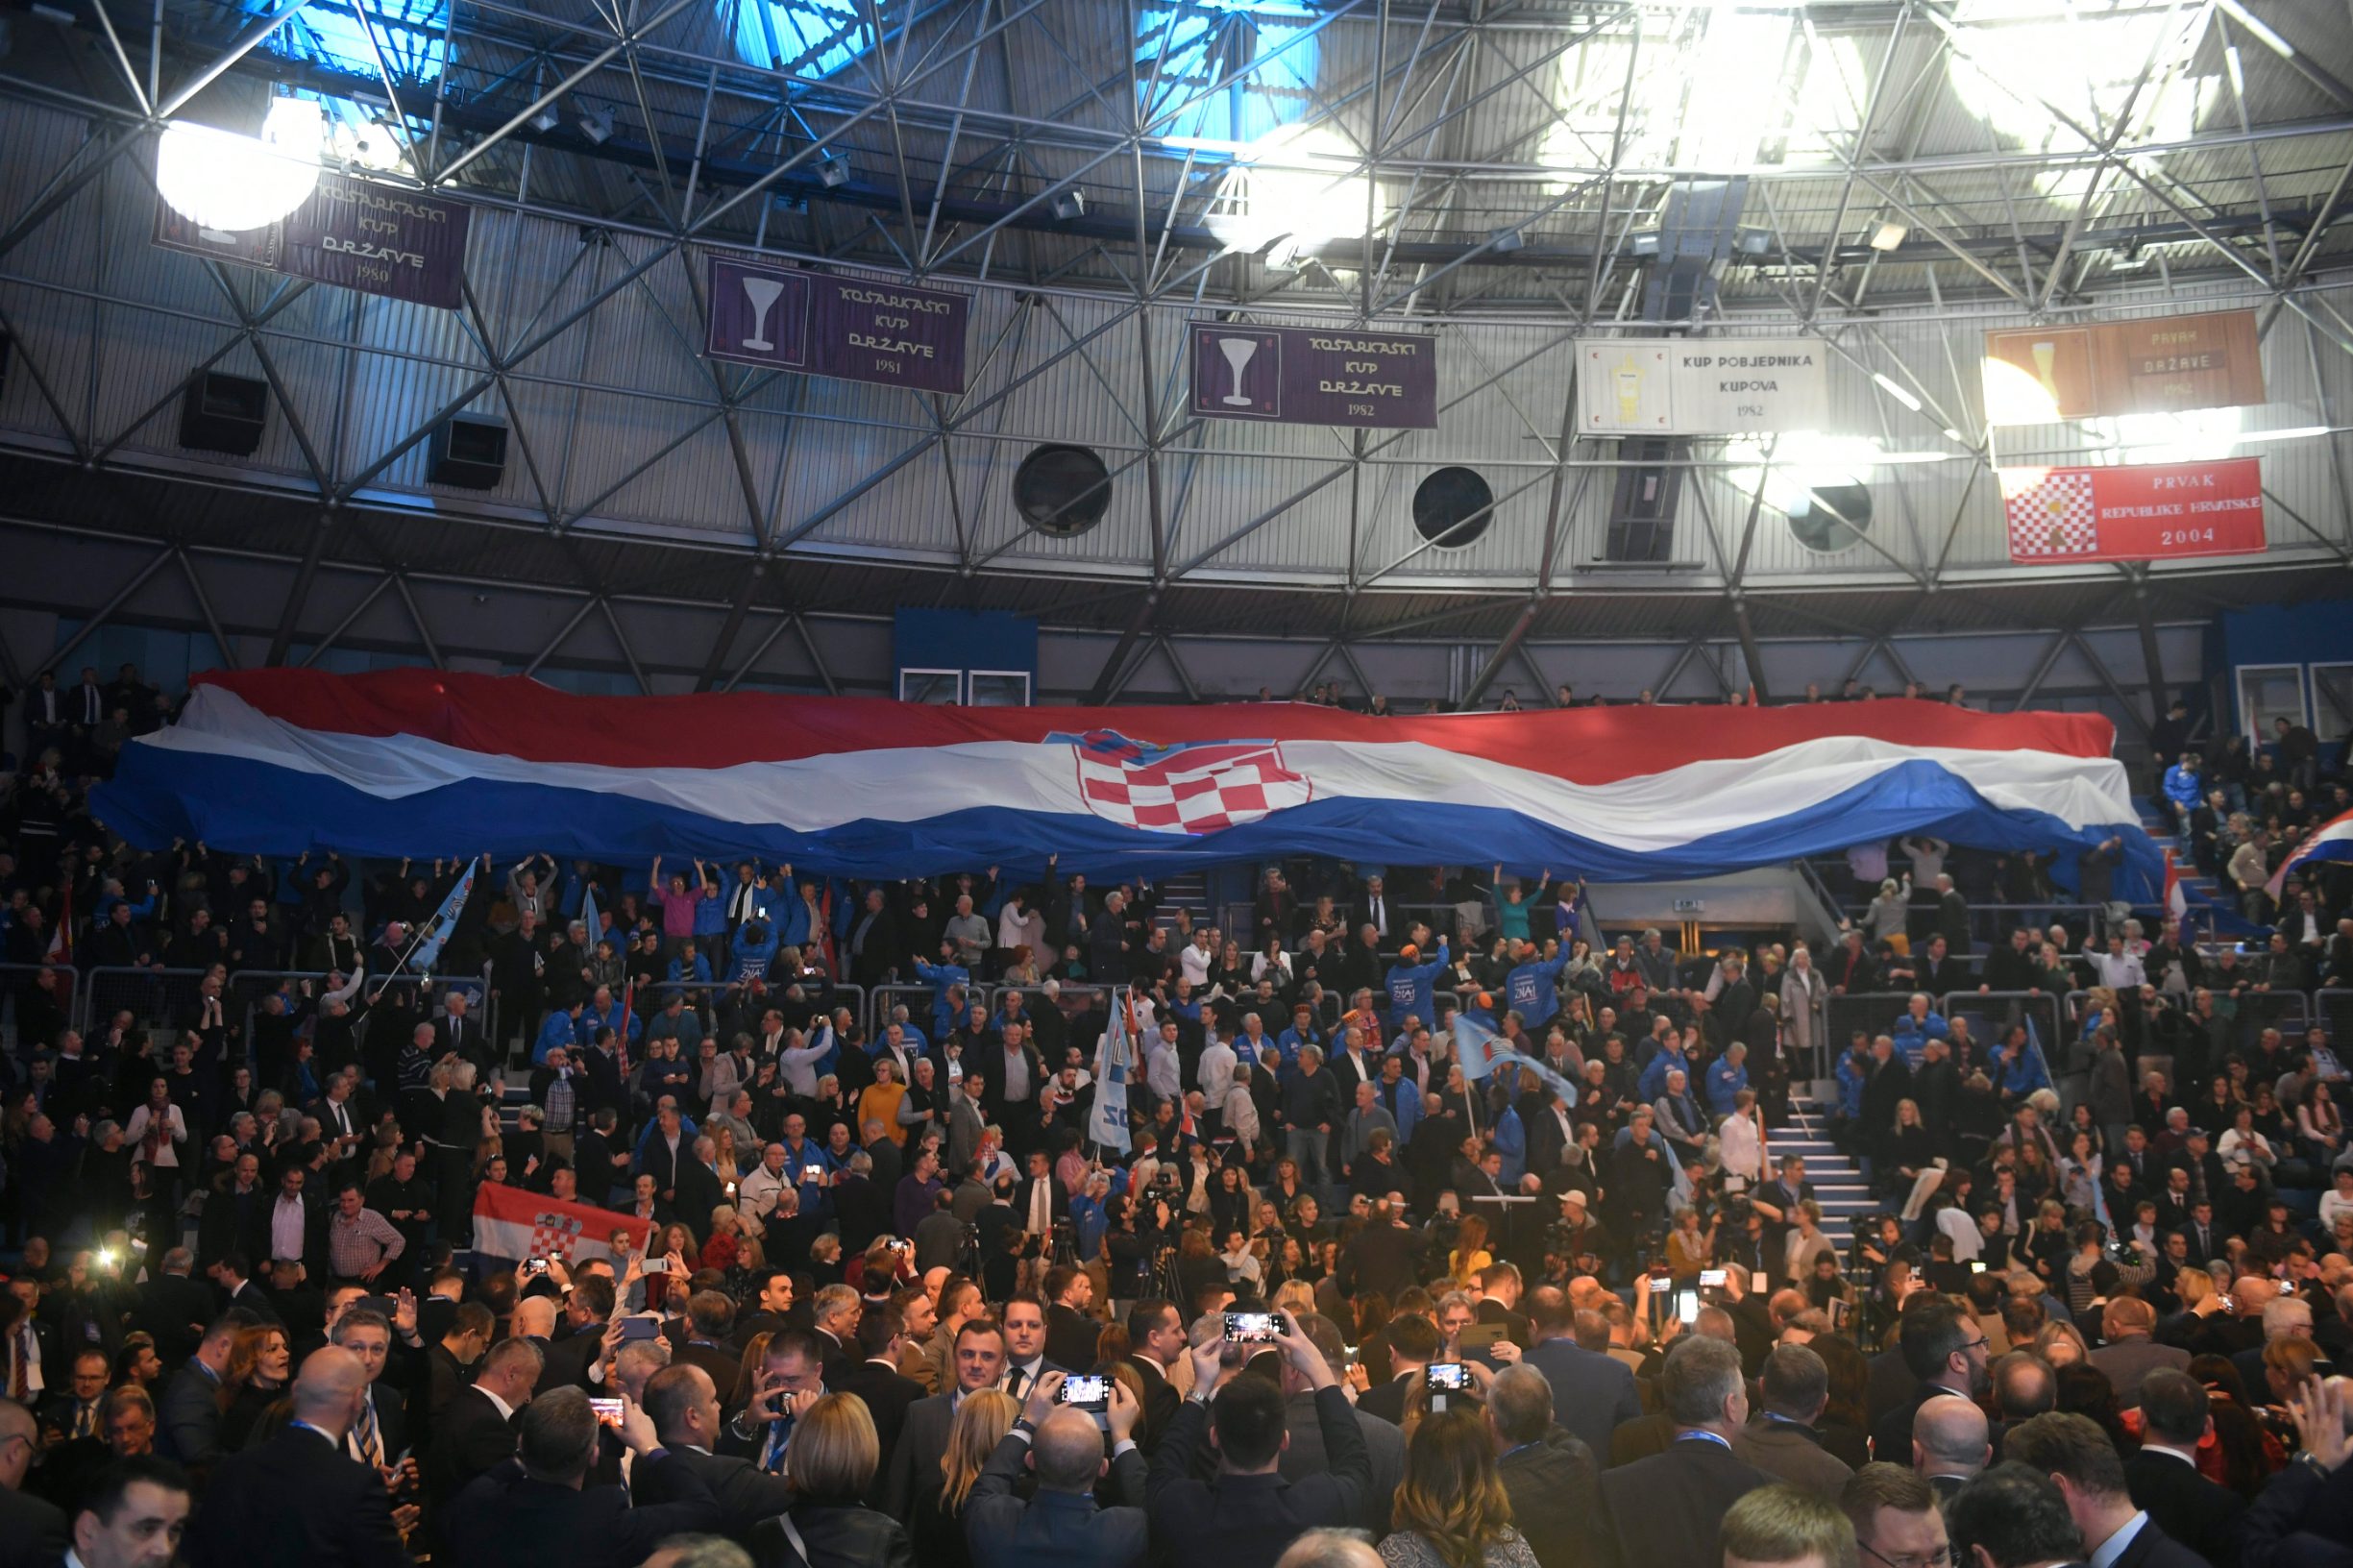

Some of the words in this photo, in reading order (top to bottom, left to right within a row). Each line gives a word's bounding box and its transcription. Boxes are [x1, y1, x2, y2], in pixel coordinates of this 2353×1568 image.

[359, 217, 398, 234] KUP
[323, 236, 425, 268] DRŽAVE
[356, 266, 389, 282] 1980
[875, 315, 910, 330] KUP
[848, 332, 934, 358] DRŽAVE
[875, 359, 900, 374] 1981
[1345, 361, 1378, 374] KUP
[1683, 356, 1712, 368] KUP
[1719, 355, 1813, 368] POBJEDNIKA
[1319, 380, 1403, 397] DRŽAVE
[1720, 380, 1777, 392] KUPOVA
[1348, 404, 1375, 416] 1982
[1737, 405, 1763, 417] 1982
[2153, 475, 2216, 490] PRVAK
[2101, 503, 2183, 520] REPUBLIKE
[2191, 497, 2262, 514] HRVATSKE
[2162, 528, 2215, 546] 2004
